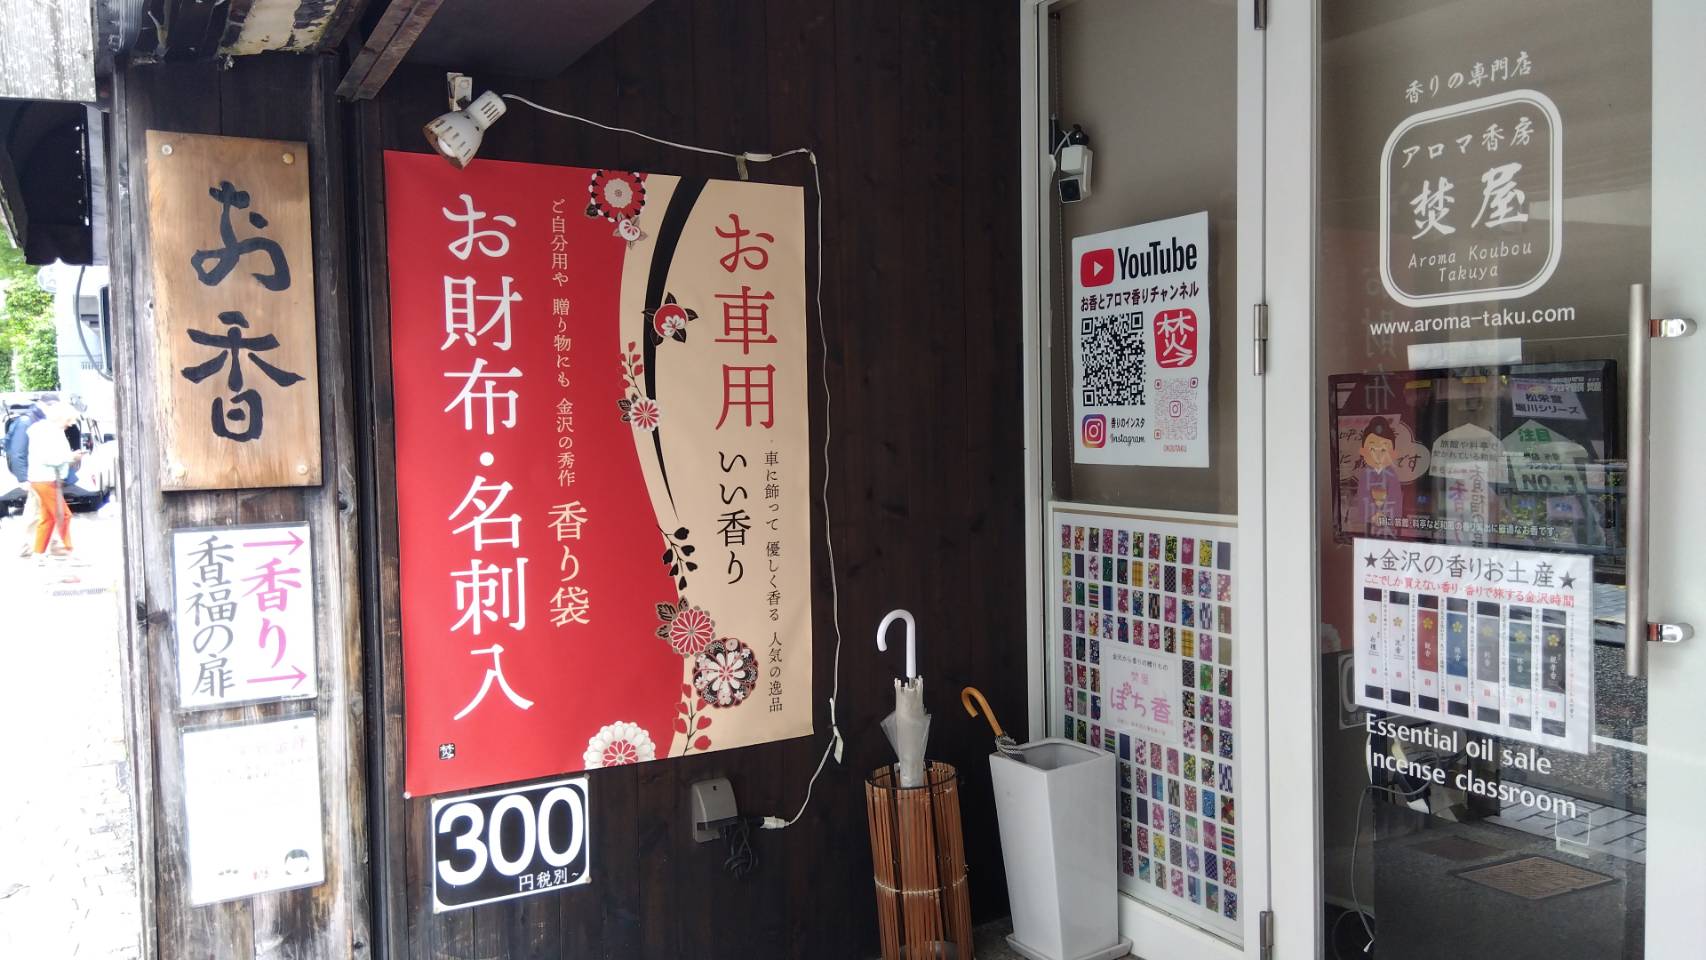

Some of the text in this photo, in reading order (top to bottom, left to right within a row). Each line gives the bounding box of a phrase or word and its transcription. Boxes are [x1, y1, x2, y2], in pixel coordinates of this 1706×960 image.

[1405, 51, 1533, 104] 香りの専門店
[1401, 116, 1535, 169] アロマ香房
[1410, 162, 1529, 240] 焚屋
[1118, 237, 1198, 280] YouTube
[1408, 240, 1532, 269] Aroma Koubou
[1439, 266, 1499, 283] Takuya
[180, 180, 307, 442] お香
[1080, 281, 1200, 312] お香とアロマ香りチャンネル
[1370, 305, 1576, 336] www.aroma-taku.com
[547, 199, 590, 628] ご自分用や 贈り物にも 金沢の秀作 香り袋
[714, 213, 777, 585] お車用 いい香り
[441, 193, 535, 721] お財布・名刺入
[1109, 433, 1146, 447] Instagram
[1519, 427, 1552, 443] 注目
[763, 451, 783, 712] 車に飾って 優しく香る 人気の逸品
[186, 534, 239, 698] 香福の扉
[241, 557, 304, 669] 香り
[1366, 712, 1552, 775] Essential oil sale
[1455, 771, 1577, 819] classroom
[437, 785, 585, 887] 300
